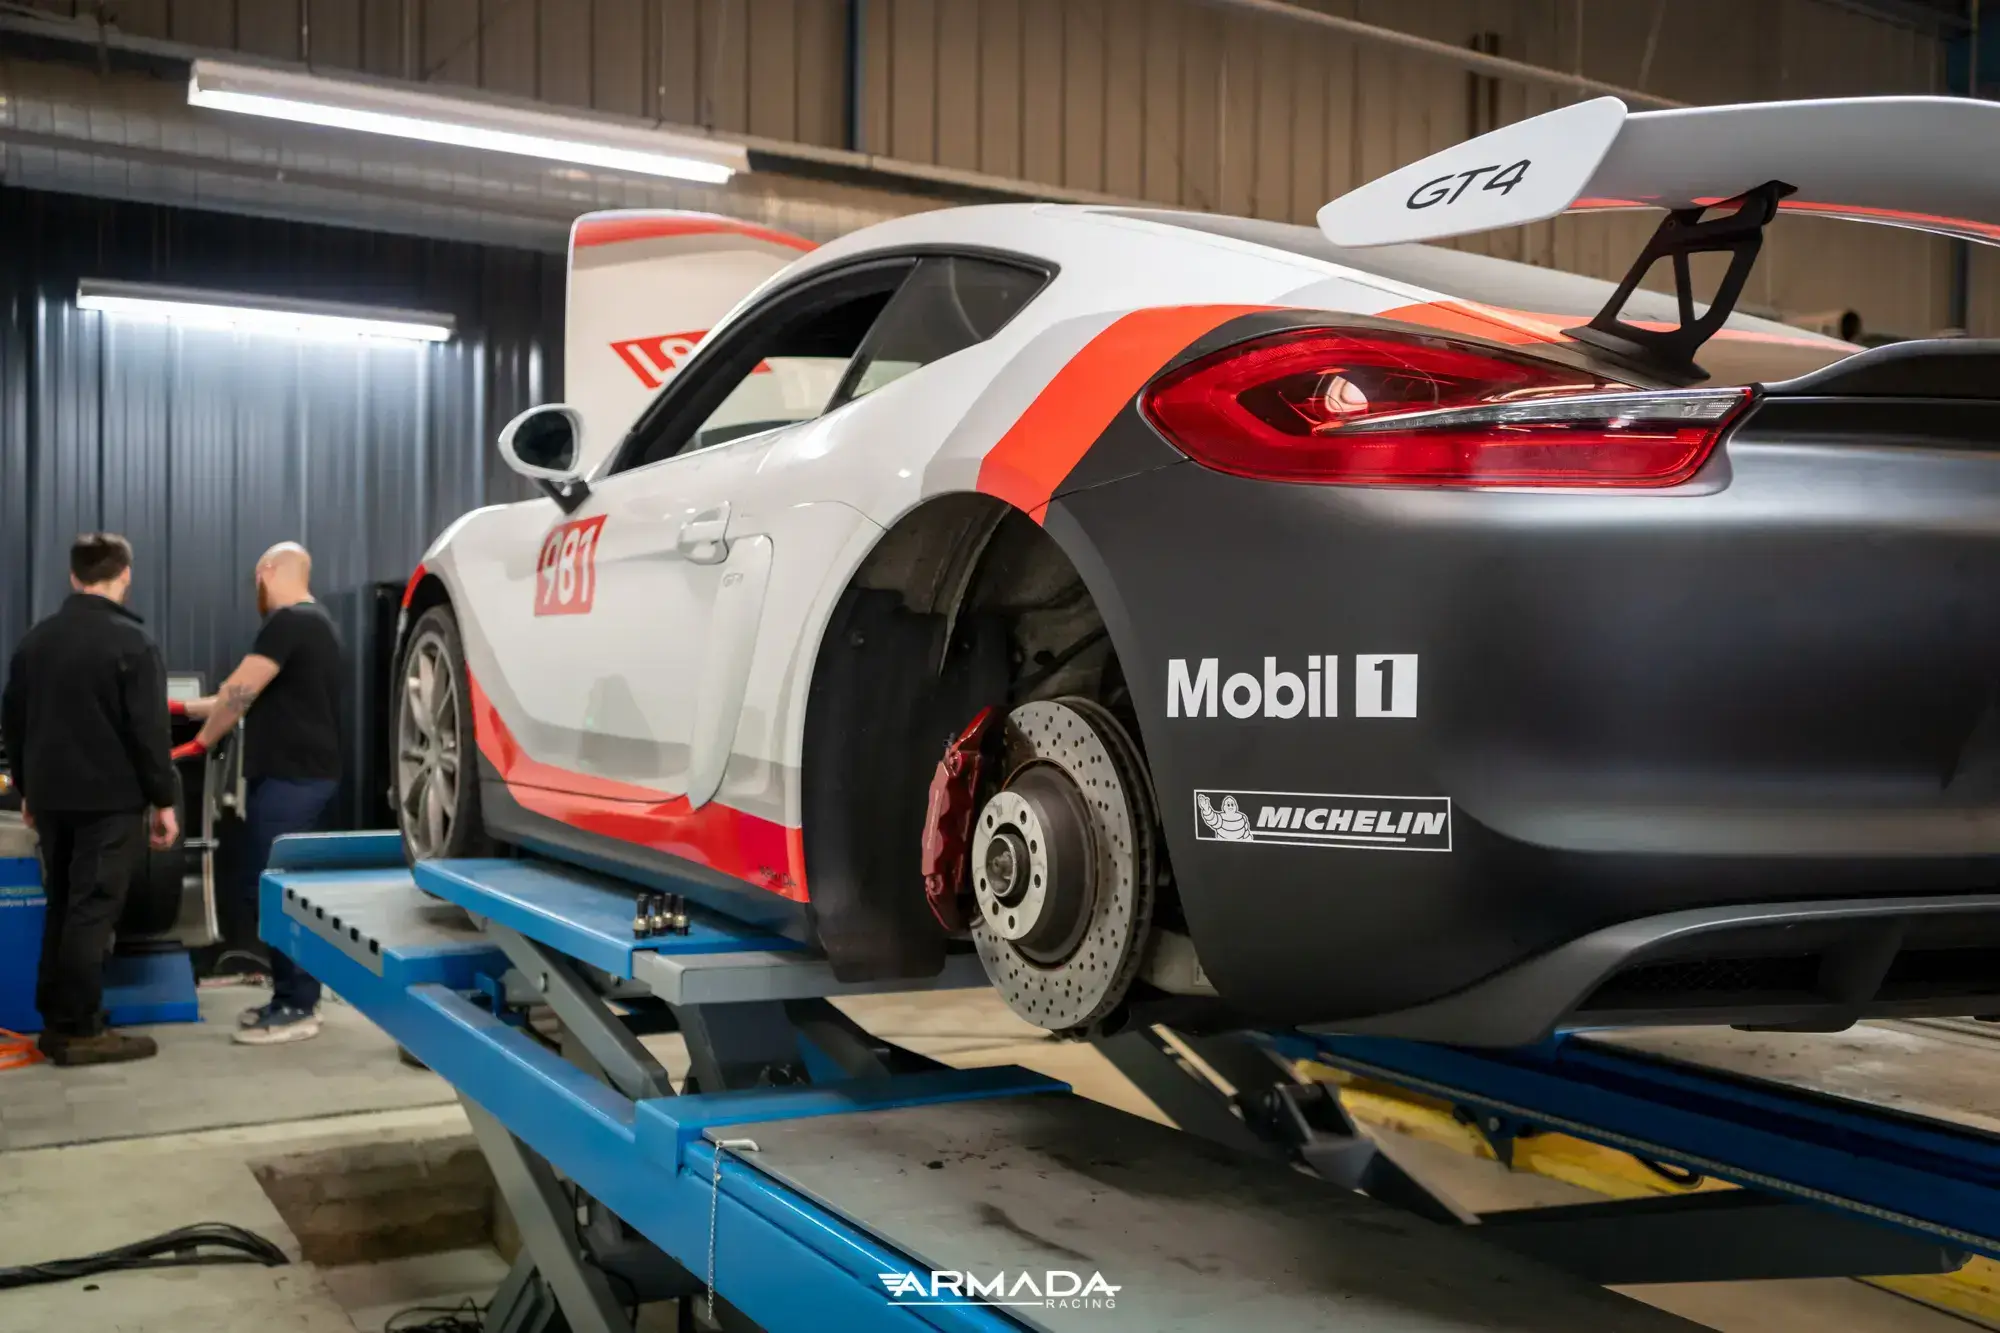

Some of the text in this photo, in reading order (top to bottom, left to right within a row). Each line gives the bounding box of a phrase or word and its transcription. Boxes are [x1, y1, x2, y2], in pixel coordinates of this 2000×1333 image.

[1406, 159, 1532, 209] GT4
[542, 524, 599, 606] 981
[1166, 655, 1338, 719] Mobil
[1256, 806, 1447, 835] MICHELIN
